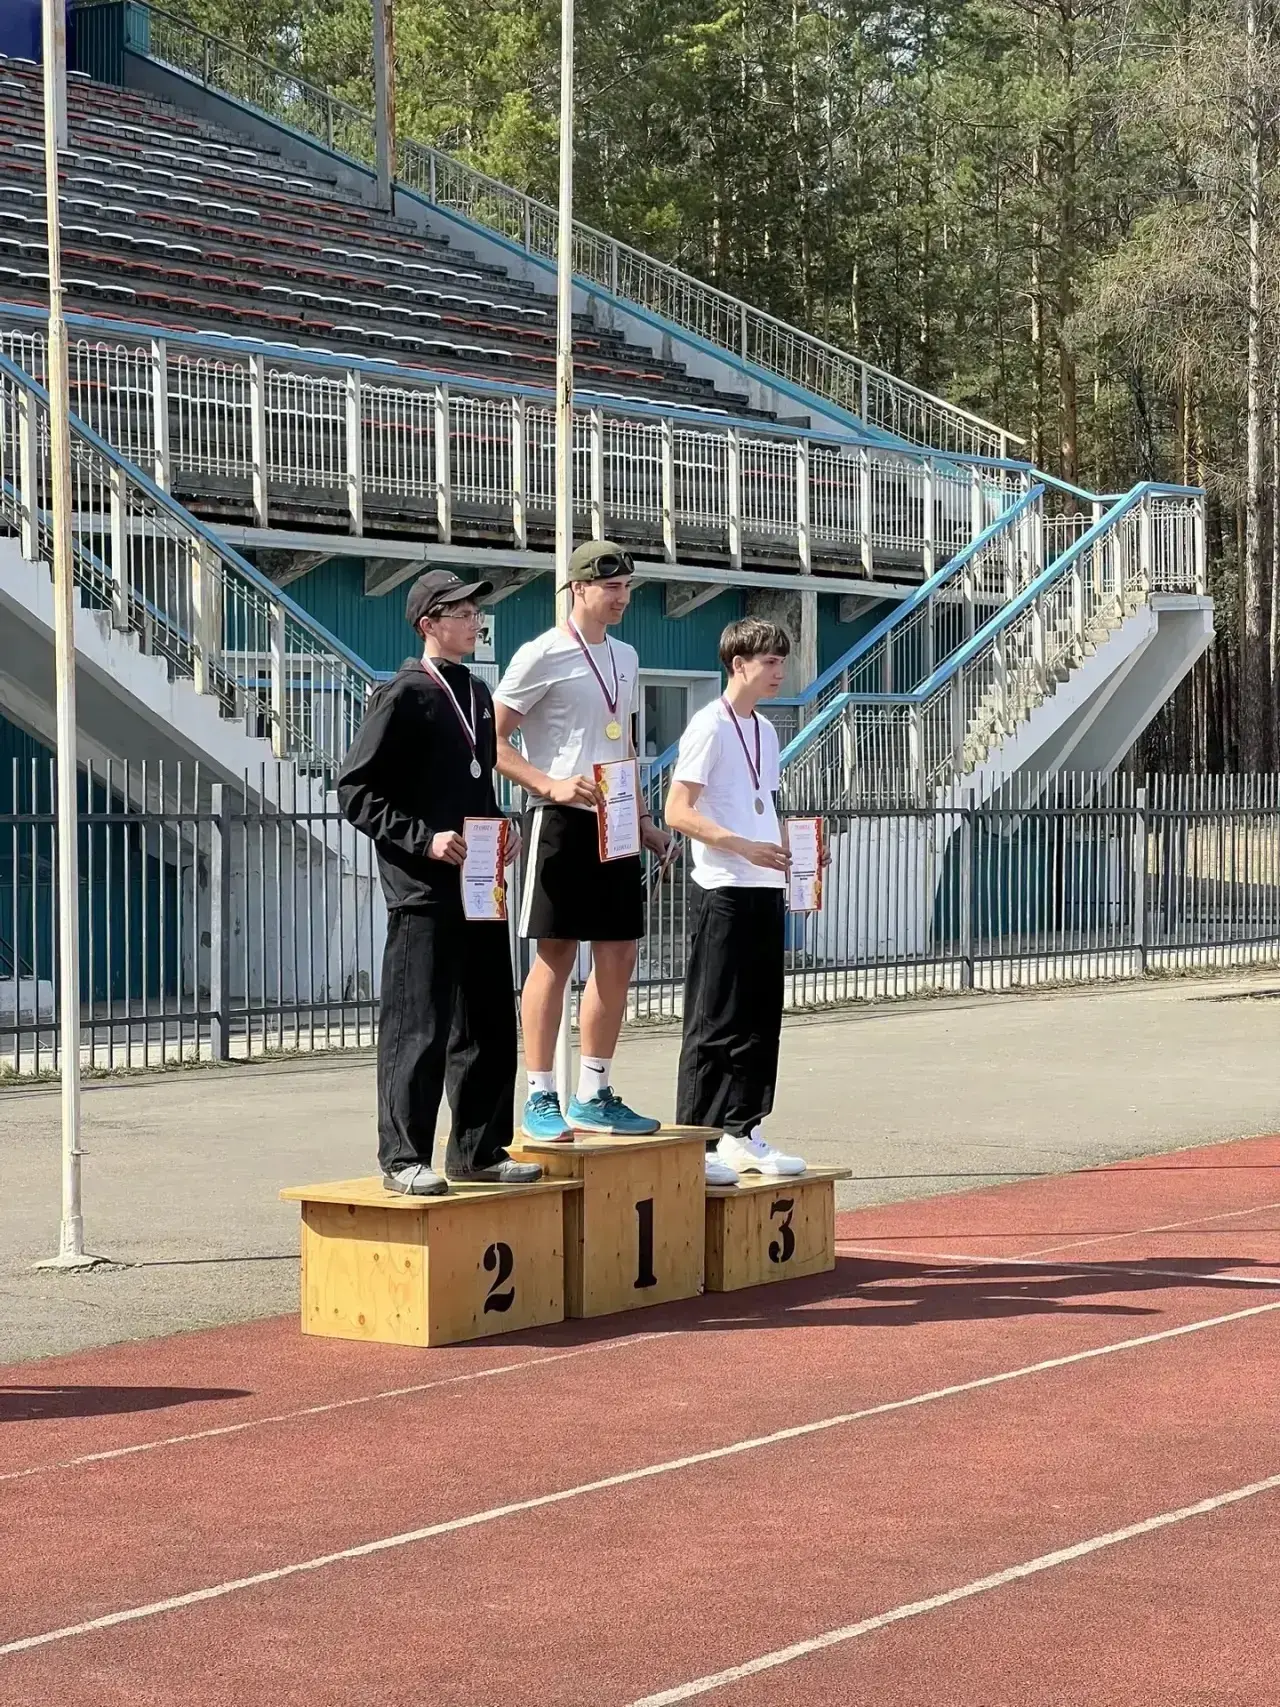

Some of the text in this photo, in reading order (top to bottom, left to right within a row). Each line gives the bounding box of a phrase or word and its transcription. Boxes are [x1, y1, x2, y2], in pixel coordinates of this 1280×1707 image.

[633, 1198, 658, 1290] 1
[768, 1198, 796, 1264] 3
[483, 1242, 516, 1315] 2
